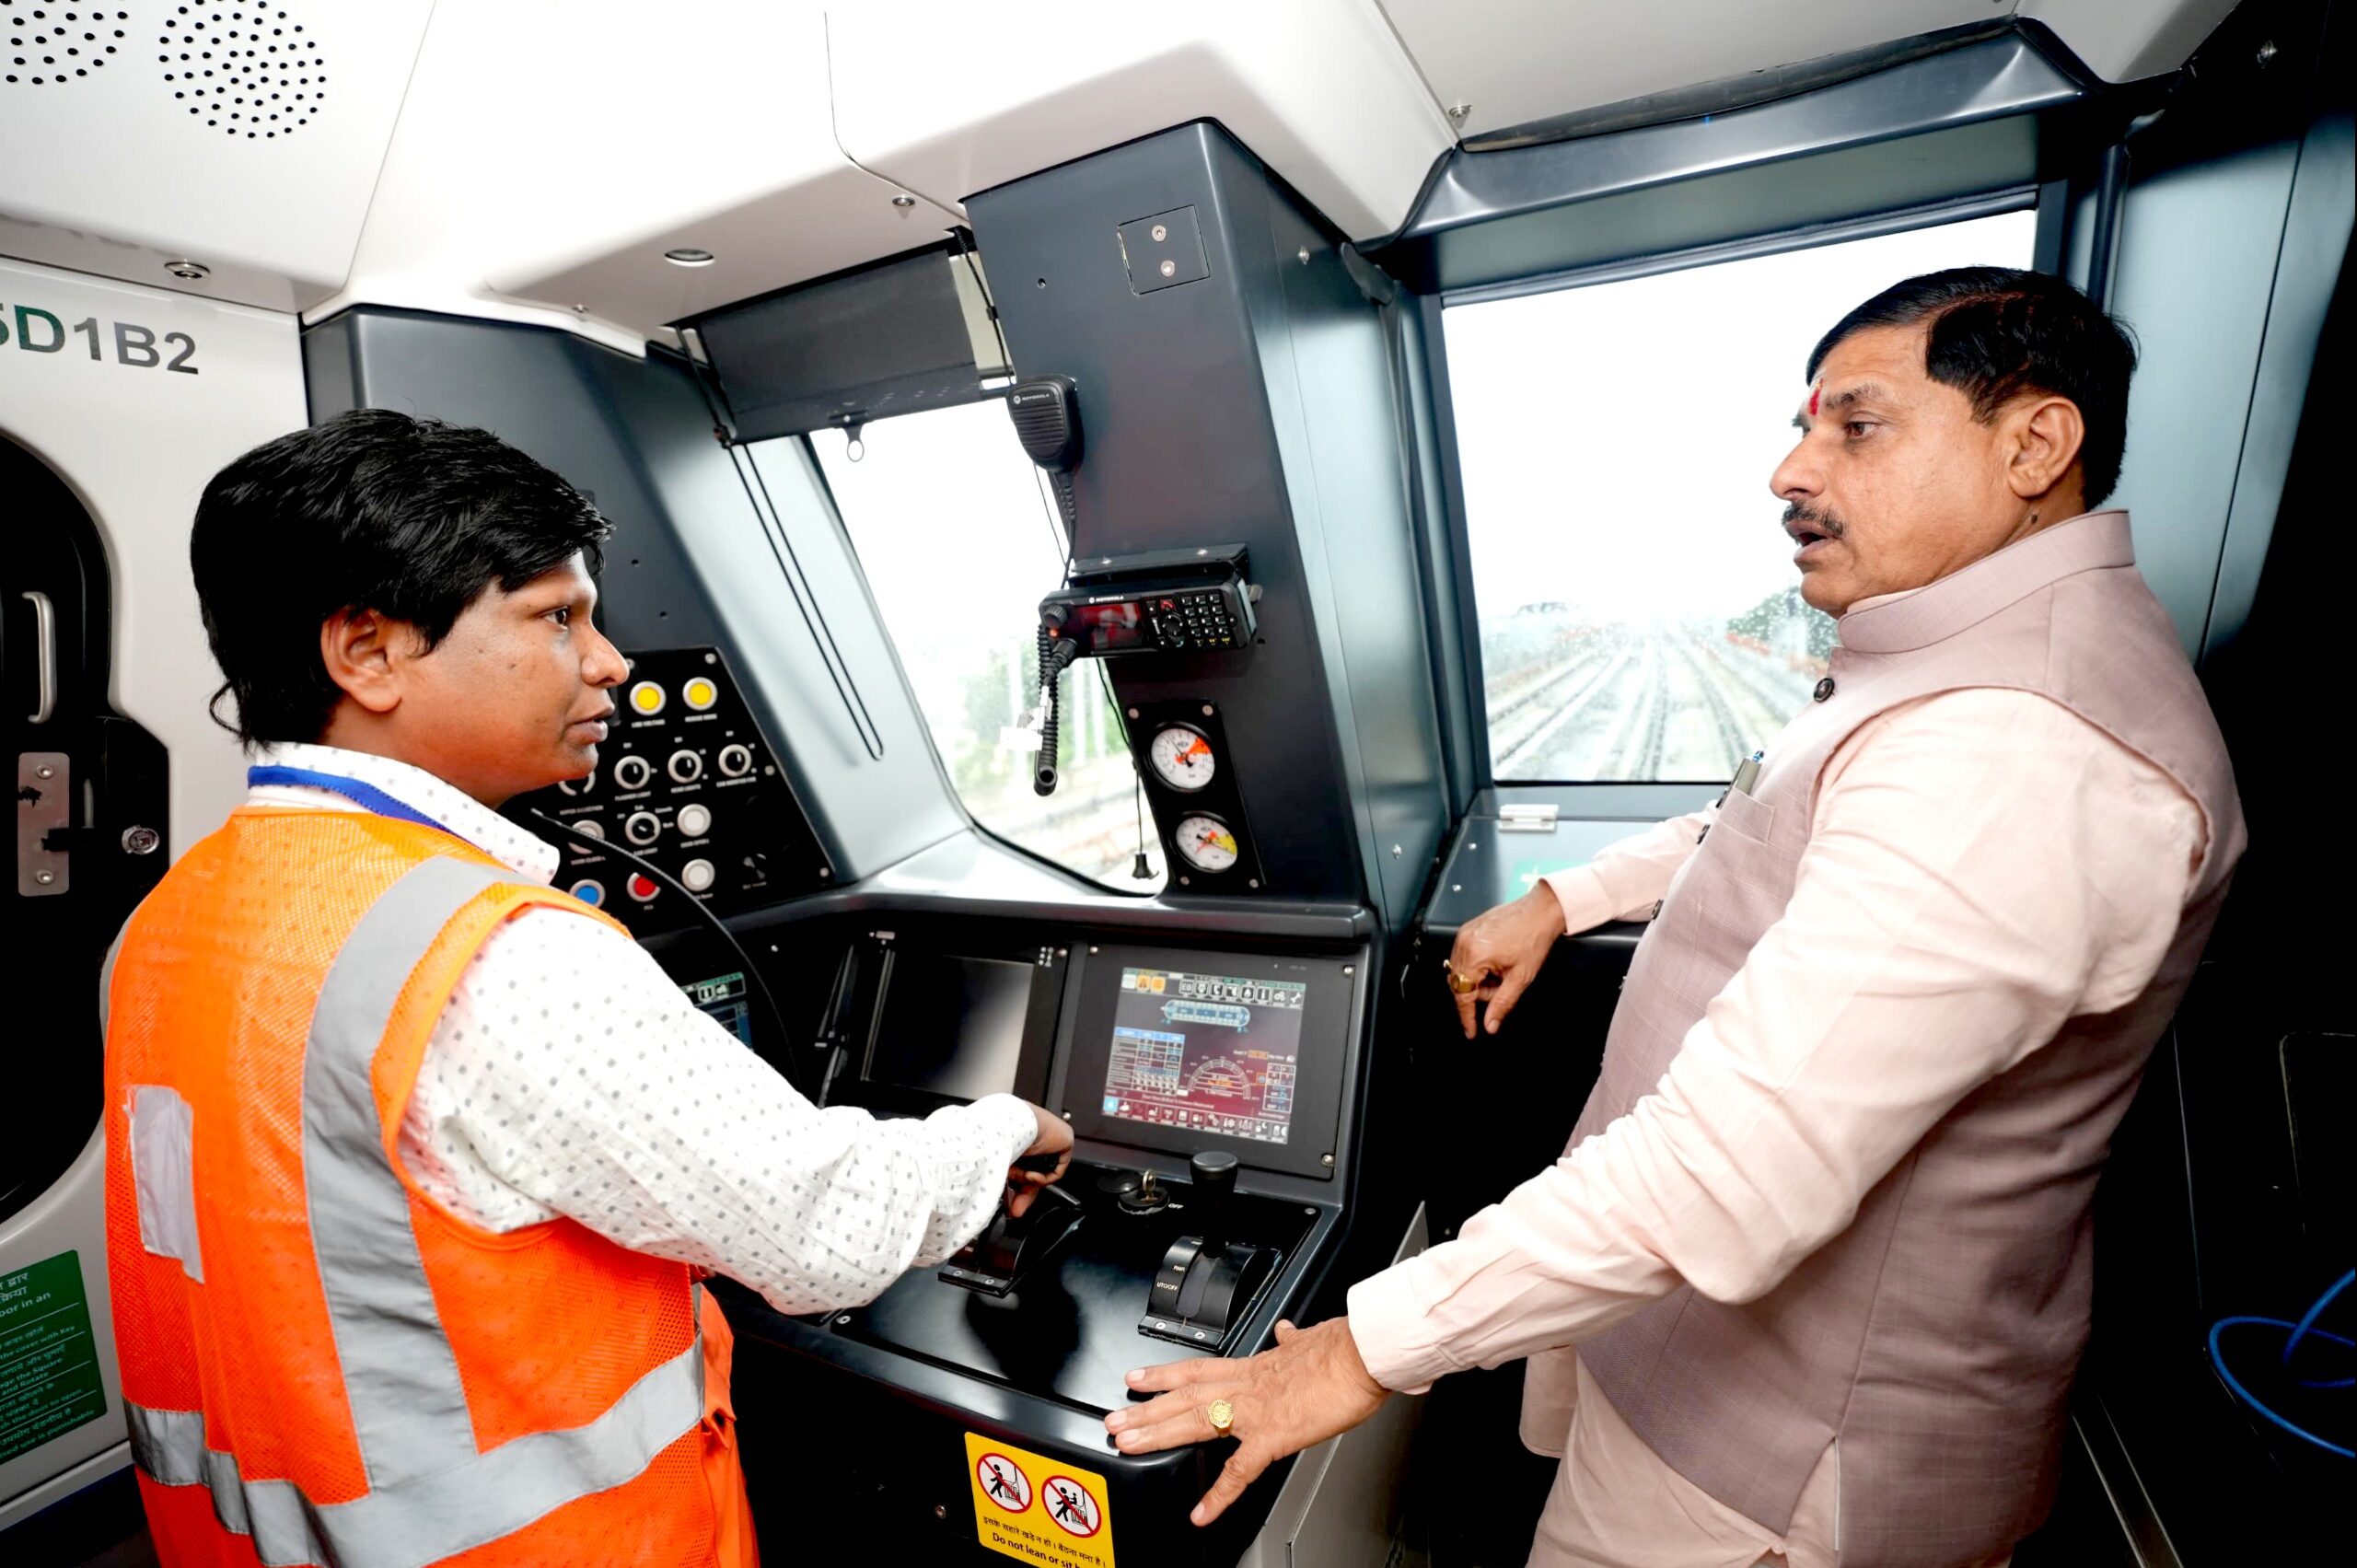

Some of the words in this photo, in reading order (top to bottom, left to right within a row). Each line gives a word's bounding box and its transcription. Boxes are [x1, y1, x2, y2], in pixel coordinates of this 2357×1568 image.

[21, 1299, 33, 1308] in
[36, 1292, 51, 1303] an
[16, 1342, 39, 1353] cover
[41, 1331, 59, 1343] with
[60, 1325, 75, 1335] Key
[17, 1372, 30, 1381] the
[32, 1357, 63, 1373] Square
[2, 1383, 18, 1396] and
[20, 1372, 48, 1388] Rotate
[12, 1414, 27, 1424] the
[993, 1532, 1005, 1545] Do
[1007, 1539, 1024, 1552] not
[1026, 1544, 1047, 1561] lean
[1049, 1555, 1059, 1565] or
